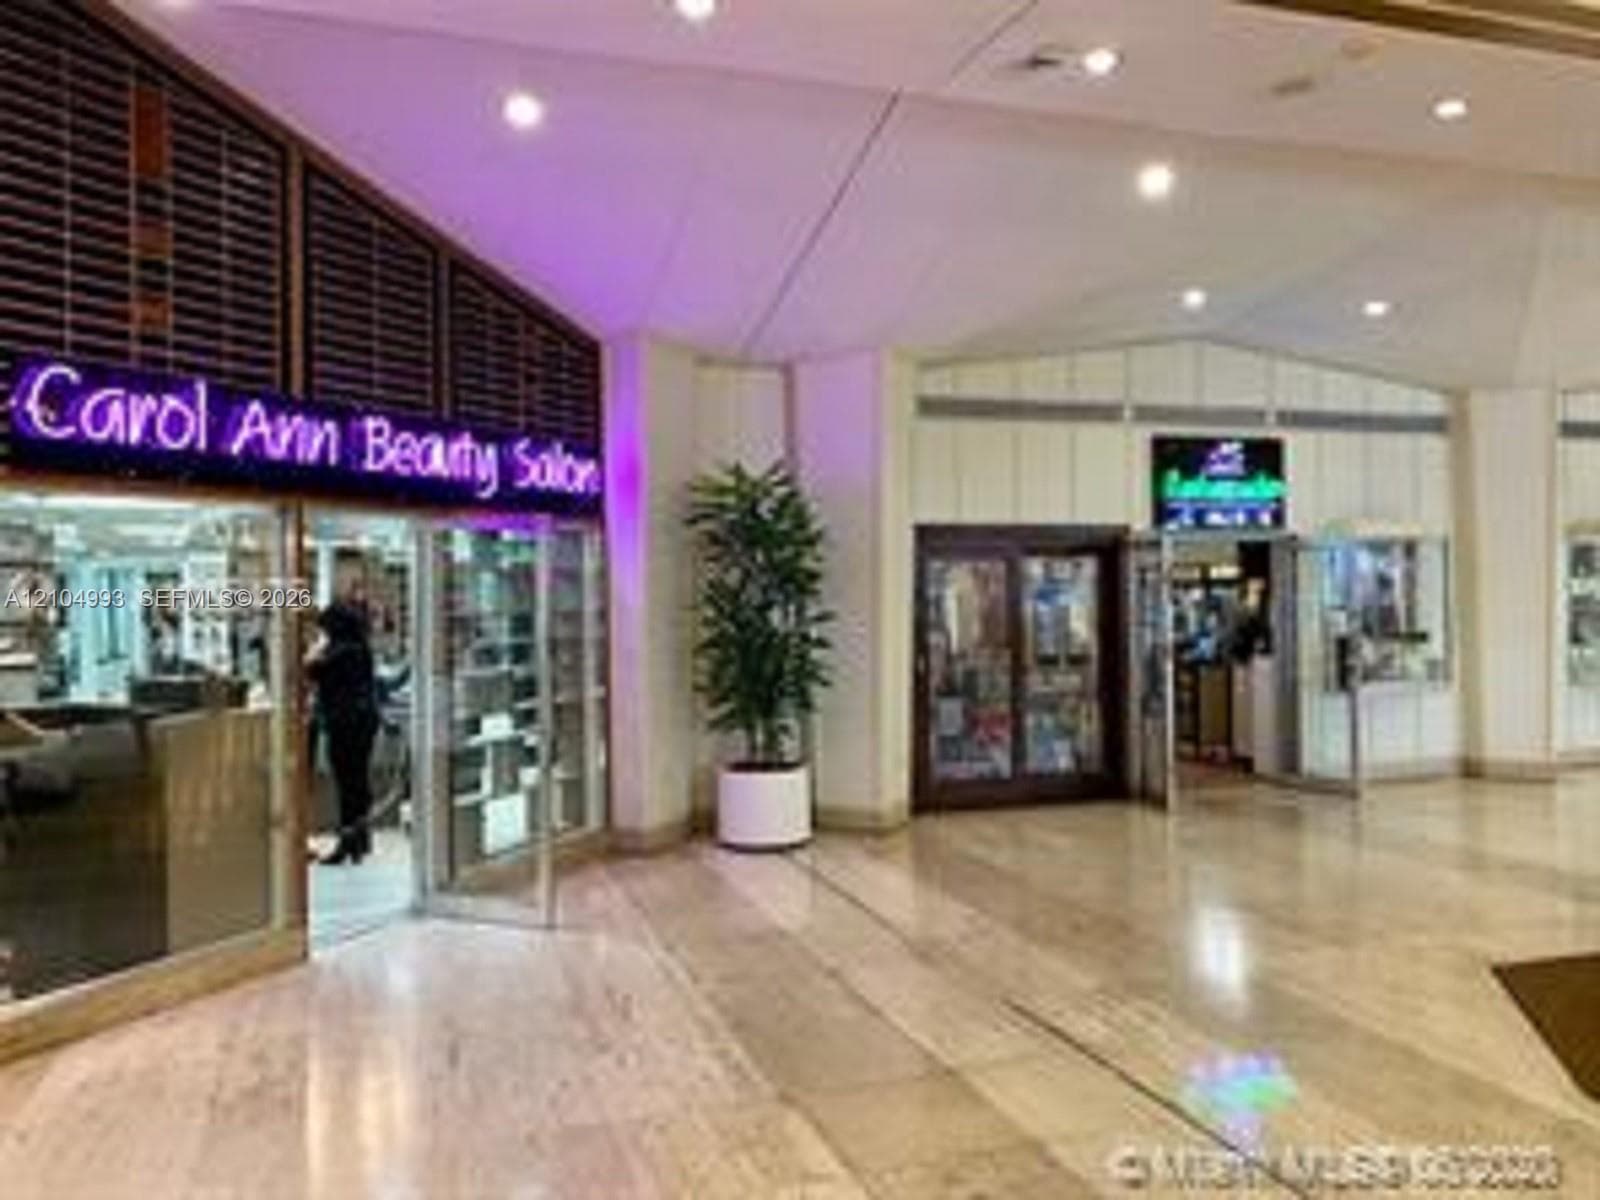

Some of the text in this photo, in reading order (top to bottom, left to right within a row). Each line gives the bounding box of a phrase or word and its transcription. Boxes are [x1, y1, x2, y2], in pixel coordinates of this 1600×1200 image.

[24, 364, 601, 499] Carol Ann Beauty Salon
